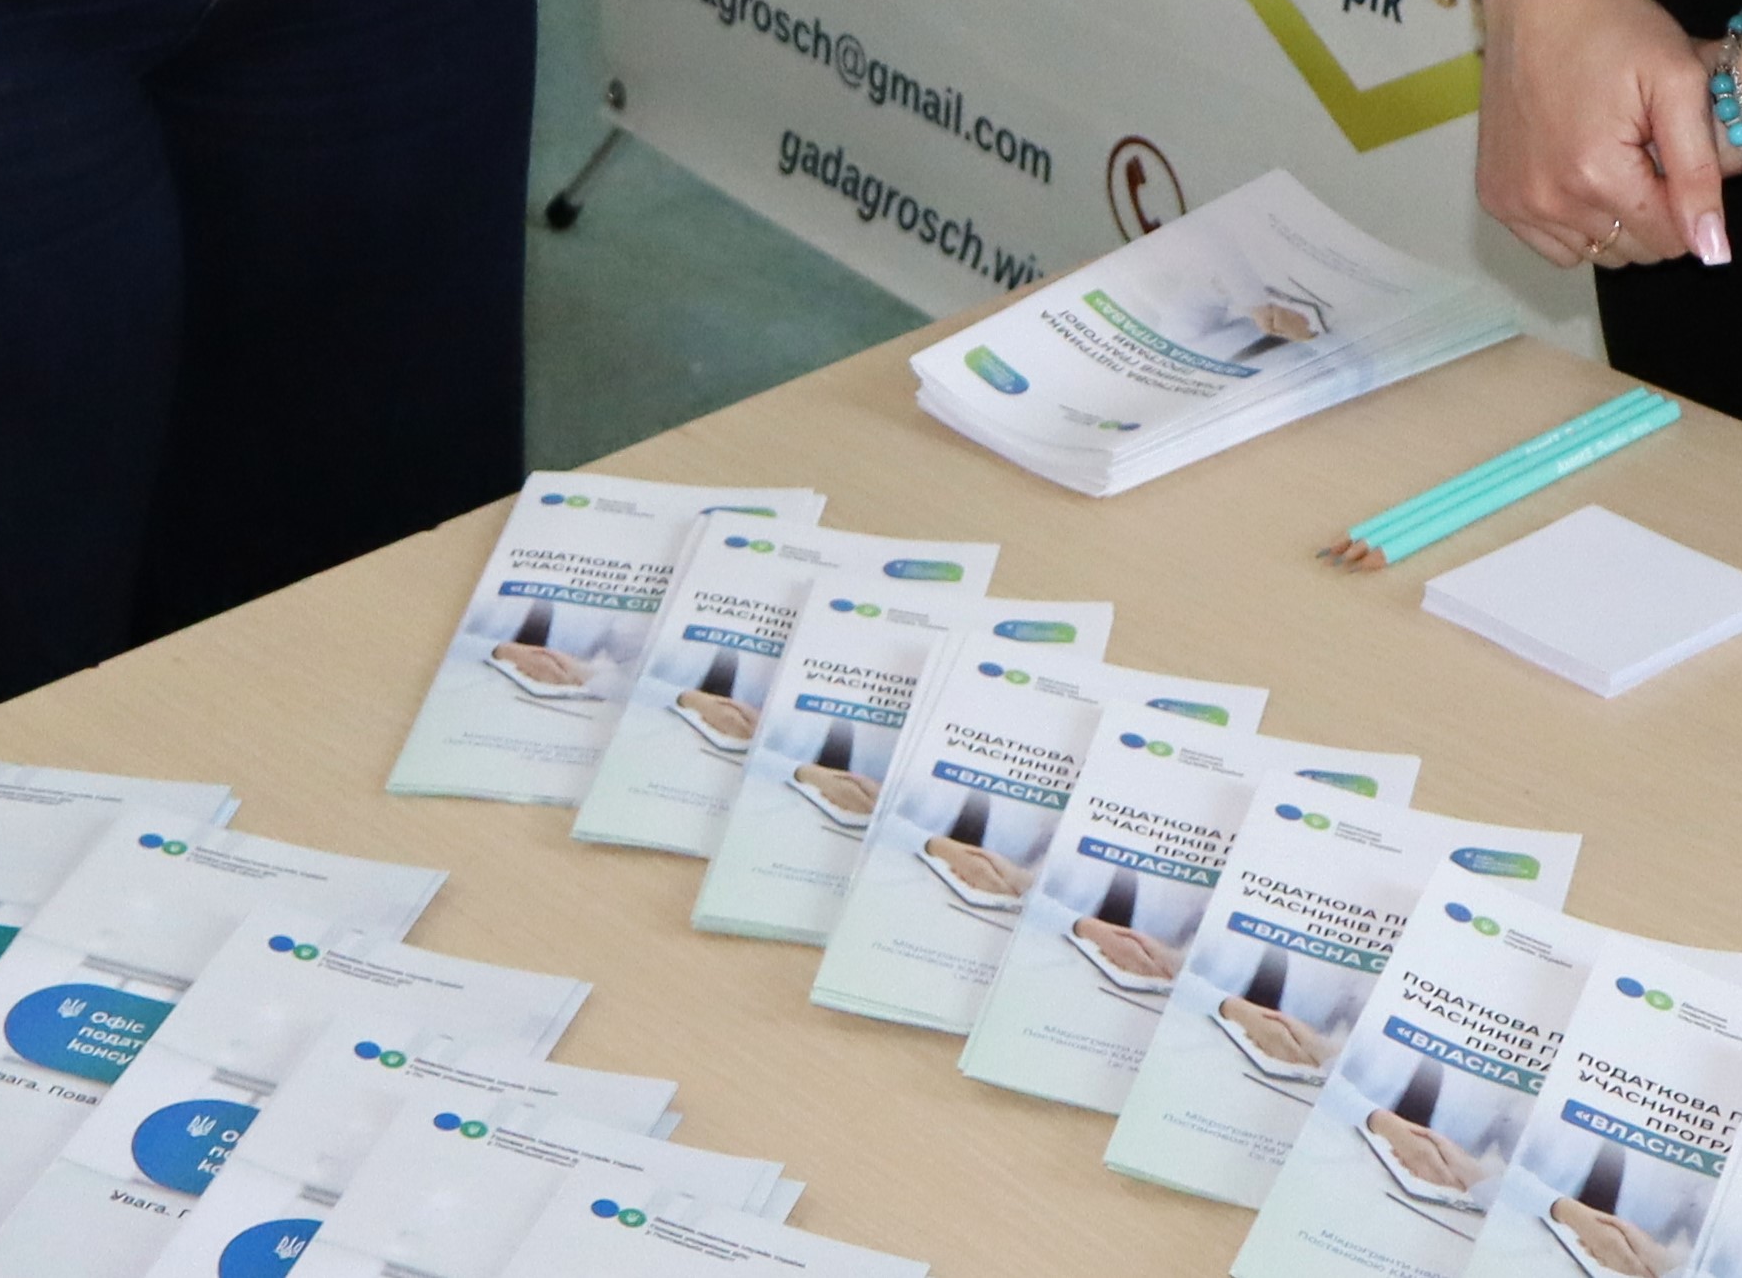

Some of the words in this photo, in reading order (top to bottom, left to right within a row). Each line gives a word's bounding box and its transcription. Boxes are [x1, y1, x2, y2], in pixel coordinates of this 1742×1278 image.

[778, 129, 1044, 291] gadagrosch.wi
[510, 548, 632, 570] ПОДАТКОВА
[945, 723, 1075, 764] ПОДАТКОВА
[947, 737, 1069, 777] УЧАСНИКІВ
[1089, 796, 1222, 840] ПОДАТКОВА
[1091, 812, 1216, 854] УЧАСНИКІВ
[1241, 871, 1377, 920] ПОДАТКОВА
[1242, 886, 1371, 933] УЧАСНИКІВ
[91, 1010, 145, 1034] Офіс
[1403, 971, 1540, 1036] ПОДАТКОВА
[1403, 988, 1533, 1050] УЧАСНИКІВ
[1578, 1052, 1722, 1117] ПОДАТКОВА
[1578, 1069, 1715, 1131] УЧАСНИКІВ
[1575, 1110, 1704, 1168] «ВЛАСНА
